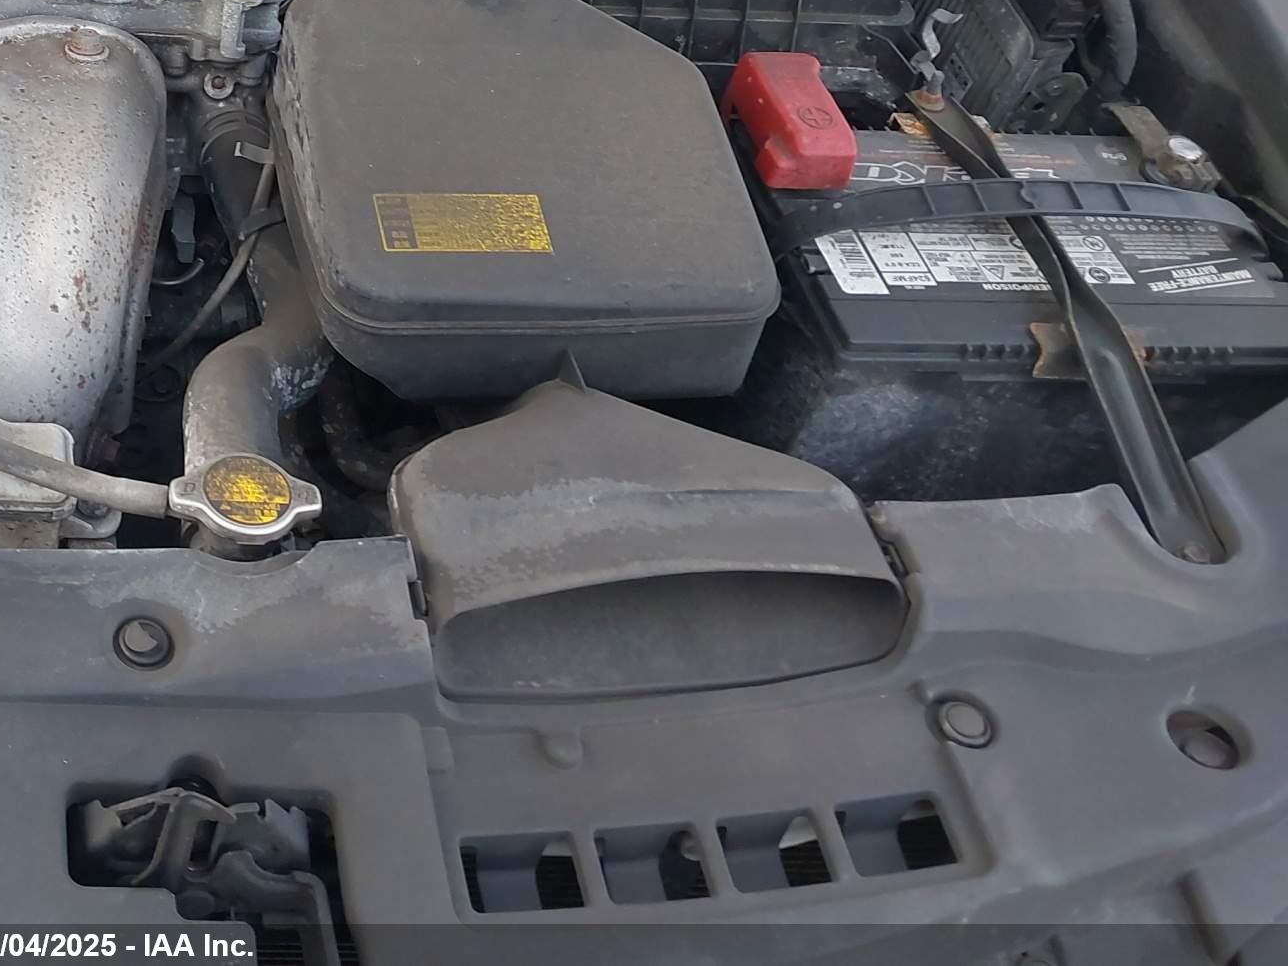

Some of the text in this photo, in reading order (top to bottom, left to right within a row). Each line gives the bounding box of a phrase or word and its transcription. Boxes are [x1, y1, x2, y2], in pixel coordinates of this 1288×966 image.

[1170, 265, 1219, 278] BATTERY
[982, 282, 1052, 292] ER/POISON
[1147, 269, 1253, 292] MAINTENANCE-FREE
